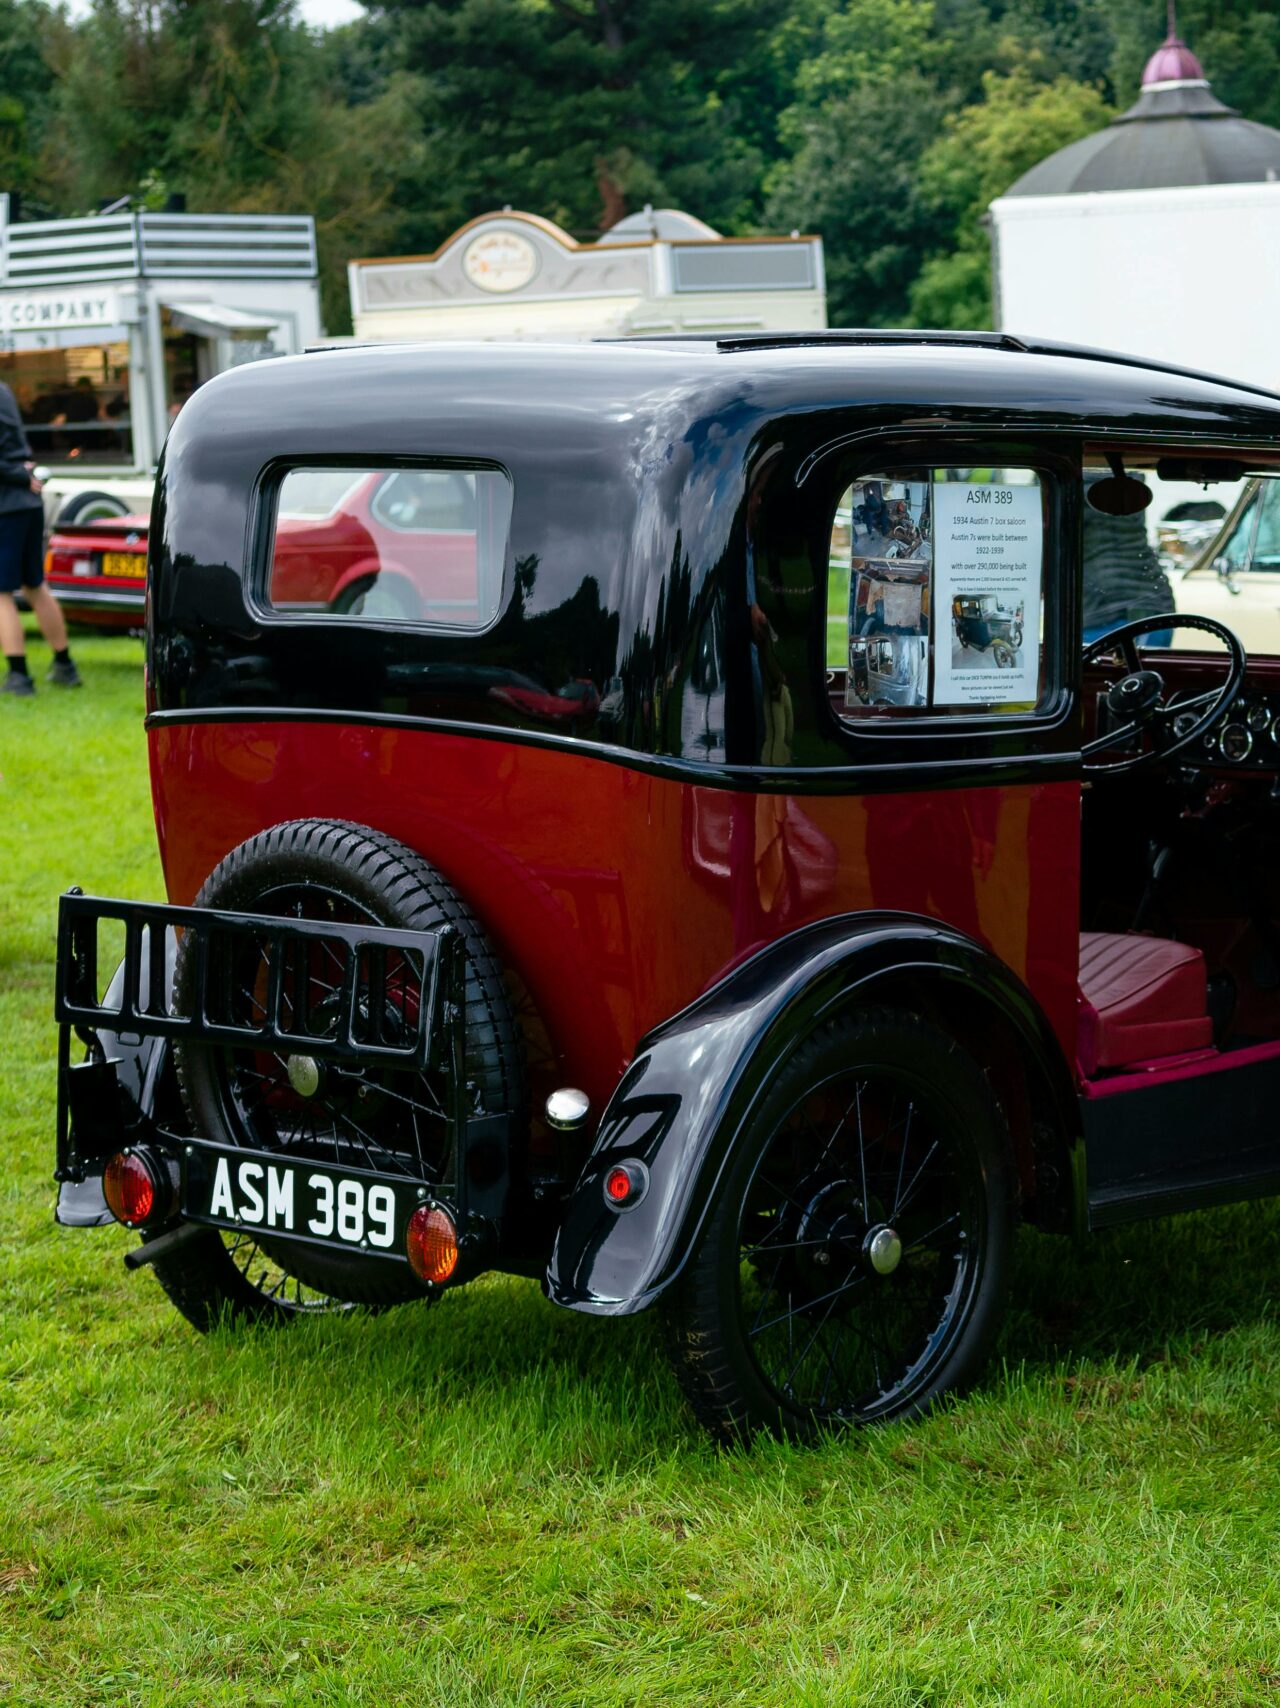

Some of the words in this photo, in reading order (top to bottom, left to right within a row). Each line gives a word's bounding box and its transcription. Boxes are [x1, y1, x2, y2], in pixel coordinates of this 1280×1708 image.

[11, 301, 106, 322] COMPANY
[966, 490, 992, 504] ASM
[994, 490, 1013, 505] 389
[953, 516, 968, 525] 1934
[969, 517, 989, 525] Austin
[990, 517, 994, 525] 7
[995, 517, 1006, 525] box
[1007, 517, 1026, 525] saloon
[951, 533, 969, 541] Austin
[976, 547, 1004, 555] 1922-1939
[951, 562, 963, 570] with
[999, 563, 1014, 571] being
[210, 1157, 294, 1230] ASM
[308, 1174, 396, 1248] 389
